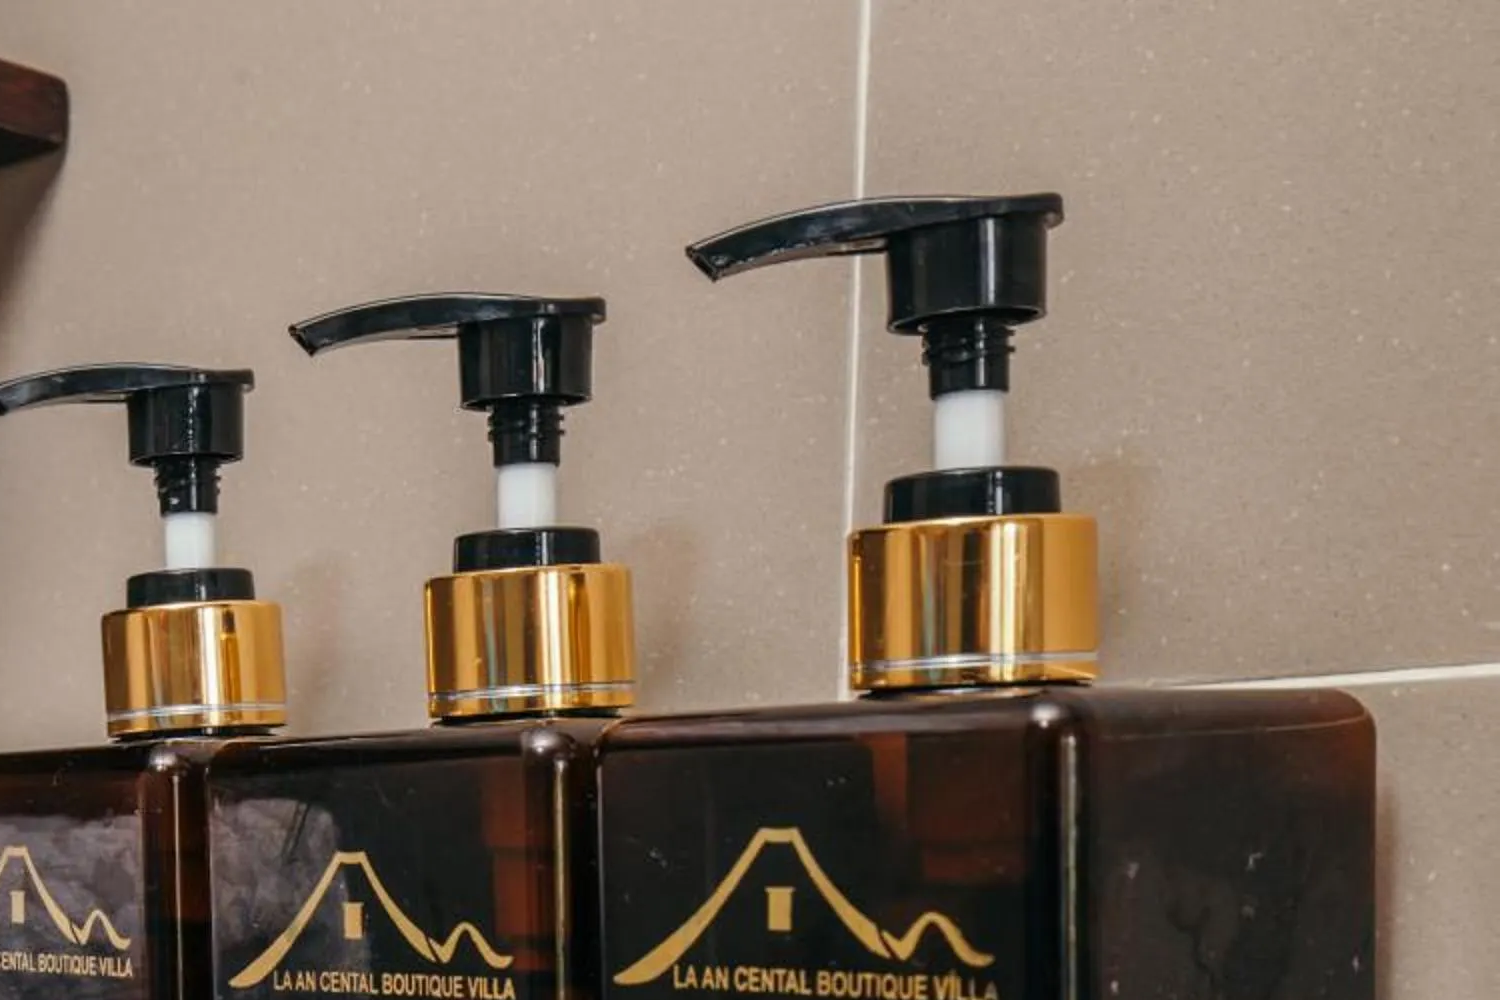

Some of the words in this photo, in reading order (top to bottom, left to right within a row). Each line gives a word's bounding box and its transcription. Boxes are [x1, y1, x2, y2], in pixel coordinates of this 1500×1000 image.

[38, 954, 97, 976] BOUTIQUE
[99, 957, 133, 978] VILLA
[273, 970, 293, 991] LA
[295, 972, 317, 992] AN
[319, 973, 378, 995] CENTAL
[381, 974, 463, 998] BOUTIQUE
[466, 976, 516, 1000] VILLA
[672, 965, 698, 989] LA
[701, 966, 730, 992] AN
[733, 967, 812, 995] CENTAL
[817, 971, 928, 1000] BOUTIQUE
